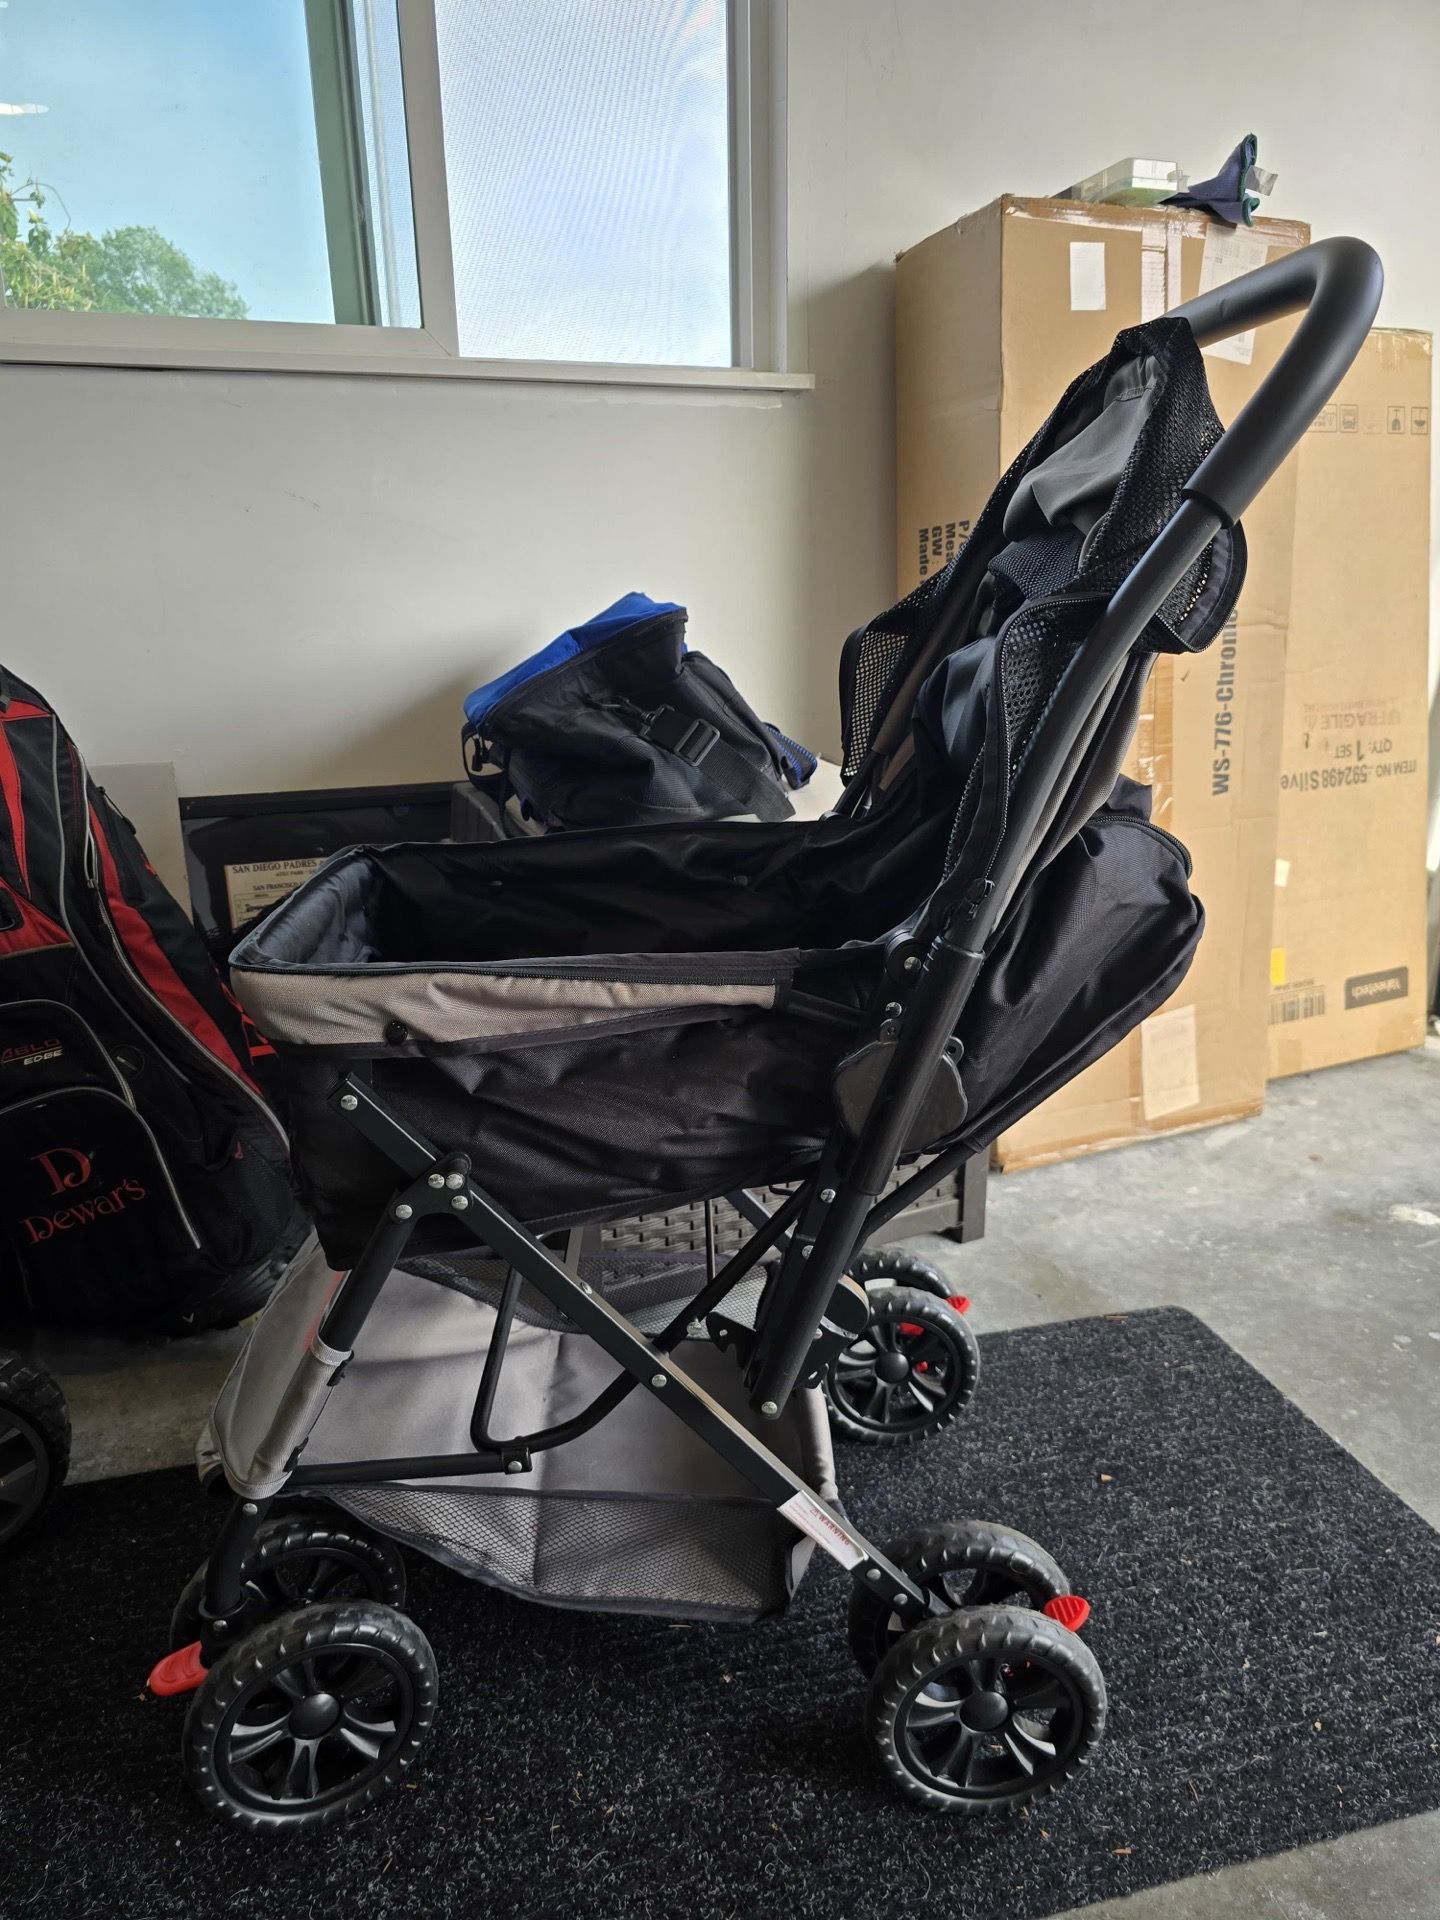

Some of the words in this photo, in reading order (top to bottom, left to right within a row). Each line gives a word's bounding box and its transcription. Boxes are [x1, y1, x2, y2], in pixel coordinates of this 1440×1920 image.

[919, 528, 929, 576] Made
[1321, 711, 1386, 730] FRAGILE
[1334, 744, 1353, 759] SET
[1356, 740, 1365, 761] 1
[1393, 760, 1417, 775] ITEM
[232, 865, 250, 874] SAN
[253, 862, 281, 872] DIEGO
[284, 860, 317, 869] PADRES
[267, 881, 298, 890] FRANCISCO
[23, 1049, 63, 1065] EDGE
[30, 1148, 91, 1195] D
[18, 1178, 146, 1244] Dewar's
[819, 1513, 851, 1546] WARNING
